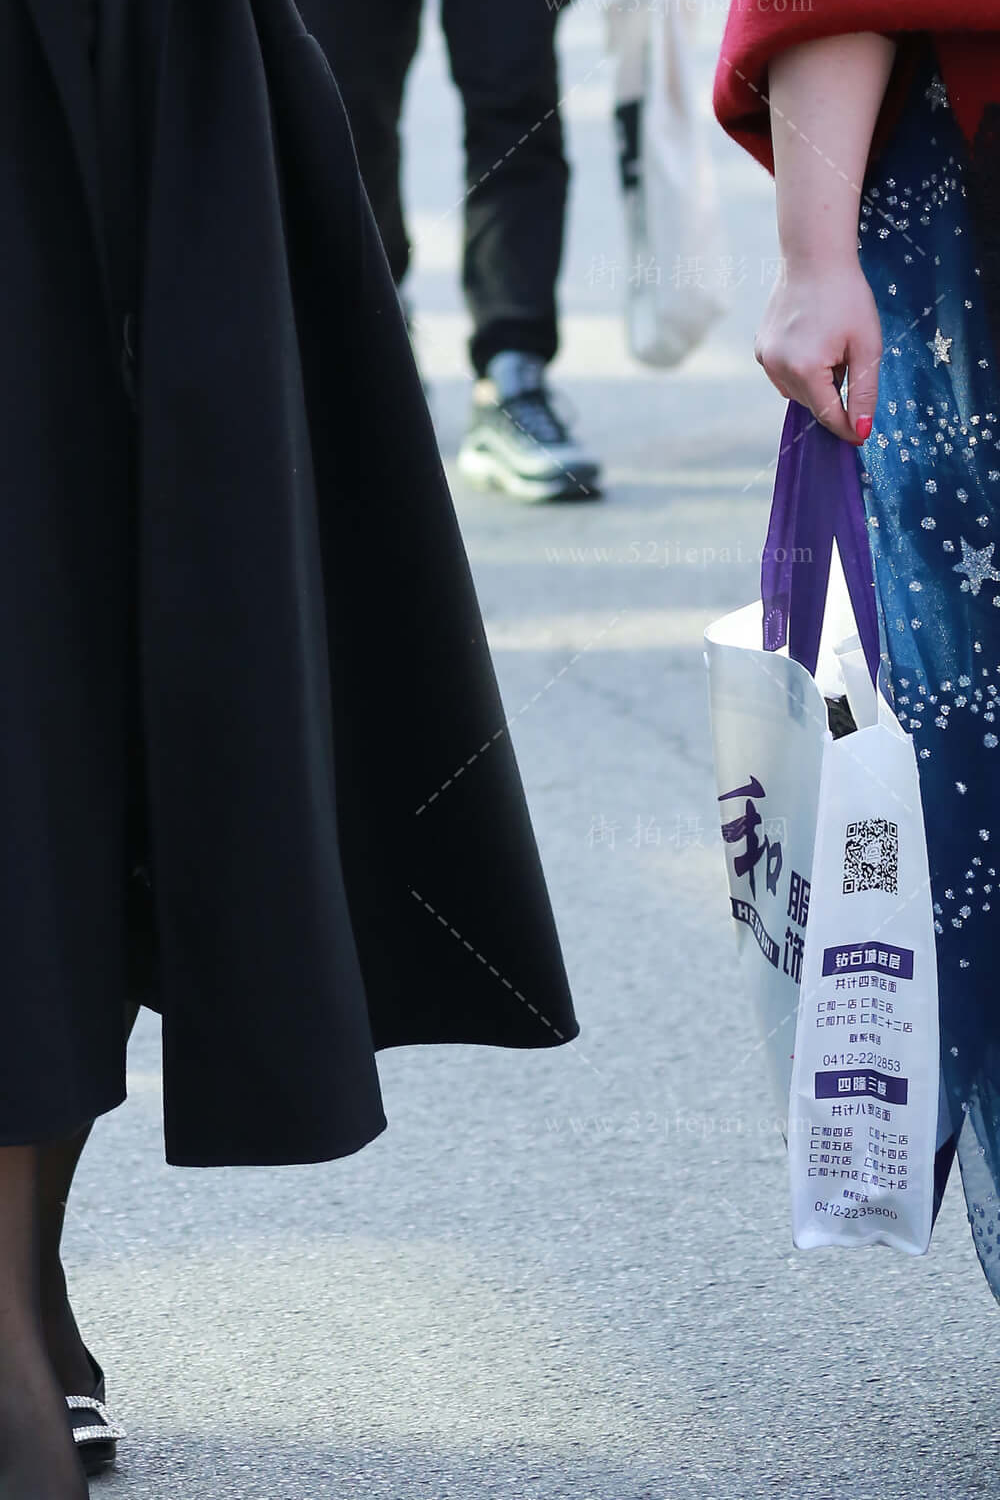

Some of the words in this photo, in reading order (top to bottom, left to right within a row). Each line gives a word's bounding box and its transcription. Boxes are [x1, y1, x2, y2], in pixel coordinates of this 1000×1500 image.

[835, 975, 897, 993] 共计四家店面
[817, 999, 857, 1012] 仁和一店
[861, 998, 894, 1013] 仁和三店
[849, 1033, 881, 1046] 联系电话
[823, 1052, 901, 1072] 0412-2212853
[831, 1103, 892, 1122] 共计八家店面
[811, 1126, 853, 1137] 仁和四店
[810, 1140, 853, 1152] 仁和五店
[814, 1201, 898, 1220] 0412-2235800
